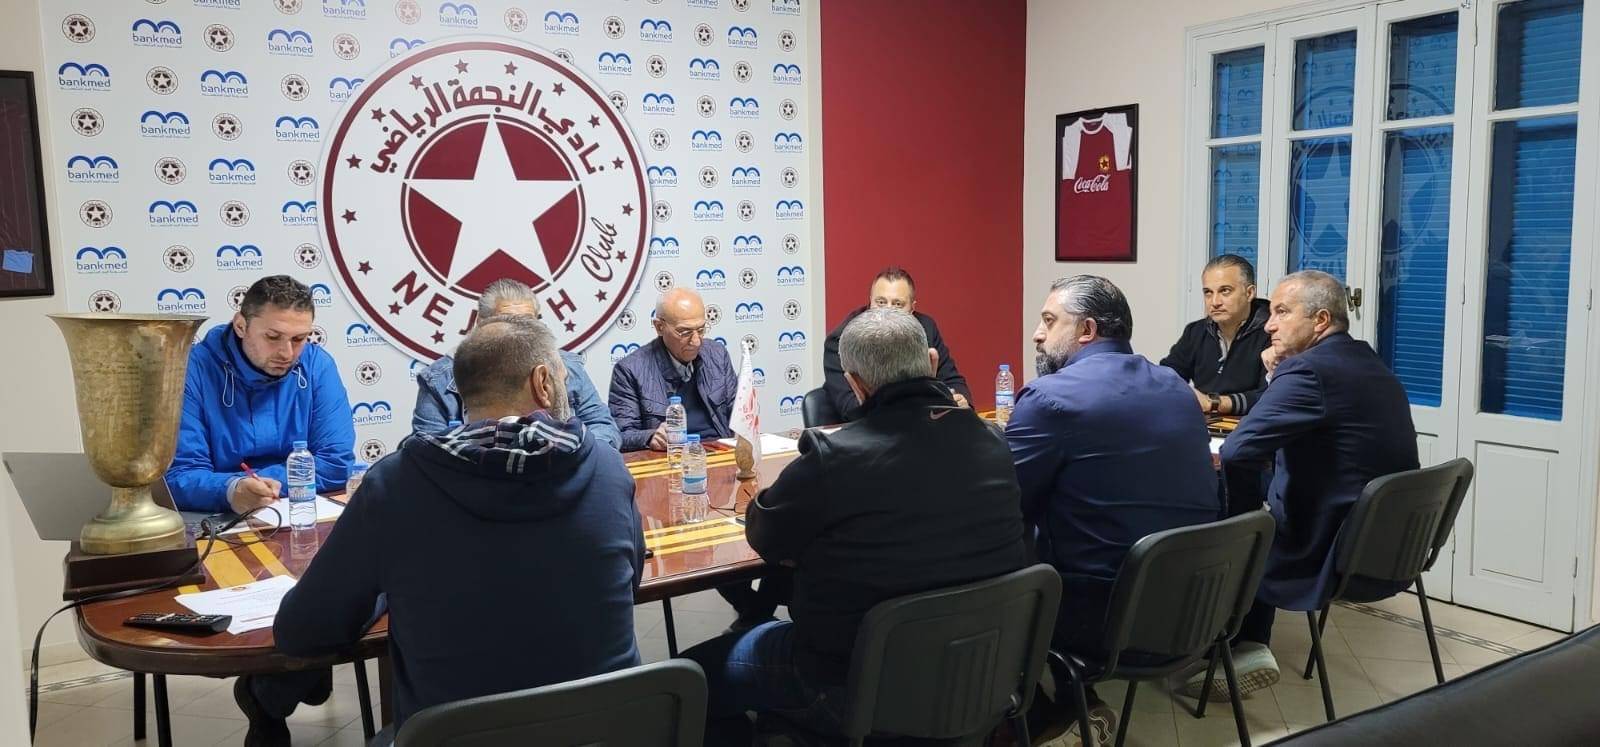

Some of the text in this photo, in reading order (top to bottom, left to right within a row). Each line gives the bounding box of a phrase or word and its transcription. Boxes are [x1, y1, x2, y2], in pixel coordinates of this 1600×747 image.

[323, 6, 367, 17] bankmed
[440, 15, 478, 25] bankmed
[544, 23, 580, 33] bankmed
[132, 33, 183, 45] bankmed
[268, 42, 314, 54] bankmed
[58, 76, 111, 88] bankmed
[201, 84, 249, 95] bankmed
[329, 88, 352, 99] bank
[141, 125, 191, 135] bankmed
[370, 78, 605, 174] نادي النجمة الرياضي
[276, 129, 320, 139] bankmed
[68, 169, 119, 179] bankmed
[209, 172, 256, 181] bankmed
[150, 214, 199, 224] bankmed
[77, 261, 128, 270] bankmed
[216, 258, 263, 267] bankmed
[392, 217, 618, 336] NEJH Club
[158, 301, 206, 311] bankmed
